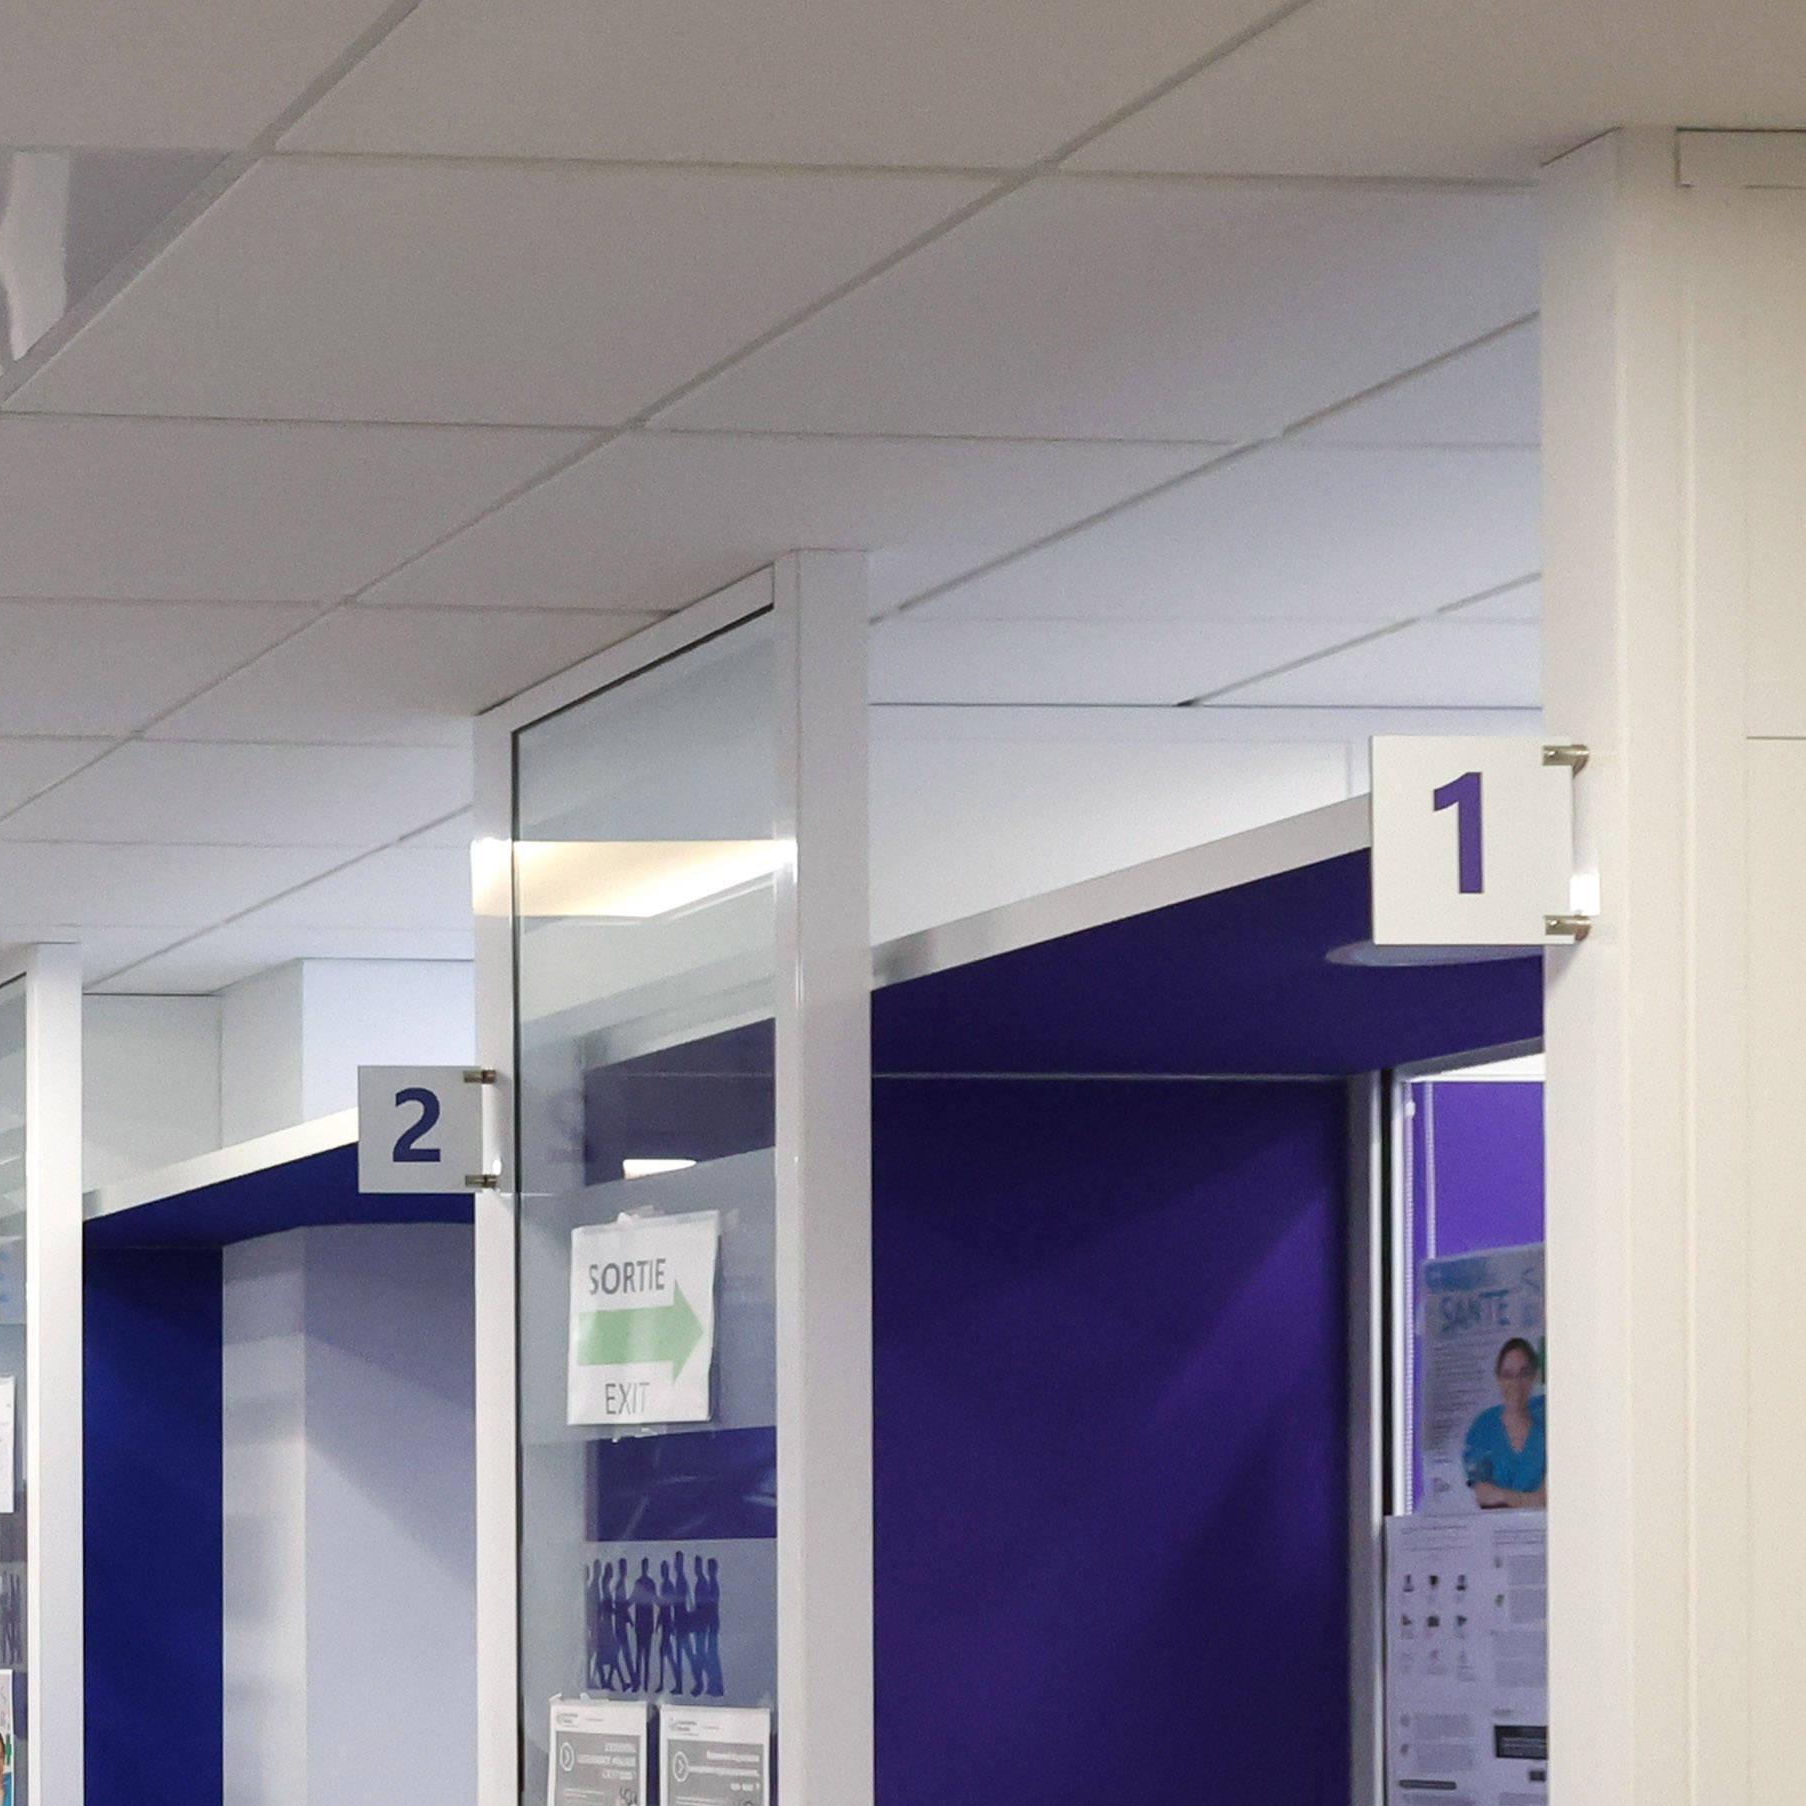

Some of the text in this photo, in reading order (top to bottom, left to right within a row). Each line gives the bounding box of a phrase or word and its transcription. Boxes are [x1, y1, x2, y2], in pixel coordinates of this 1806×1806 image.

[1433, 771, 1484, 894] 1
[392, 1087, 441, 1163] 2
[589, 1258, 666, 1295] SORTIE
[605, 1382, 650, 1415] EXIT
